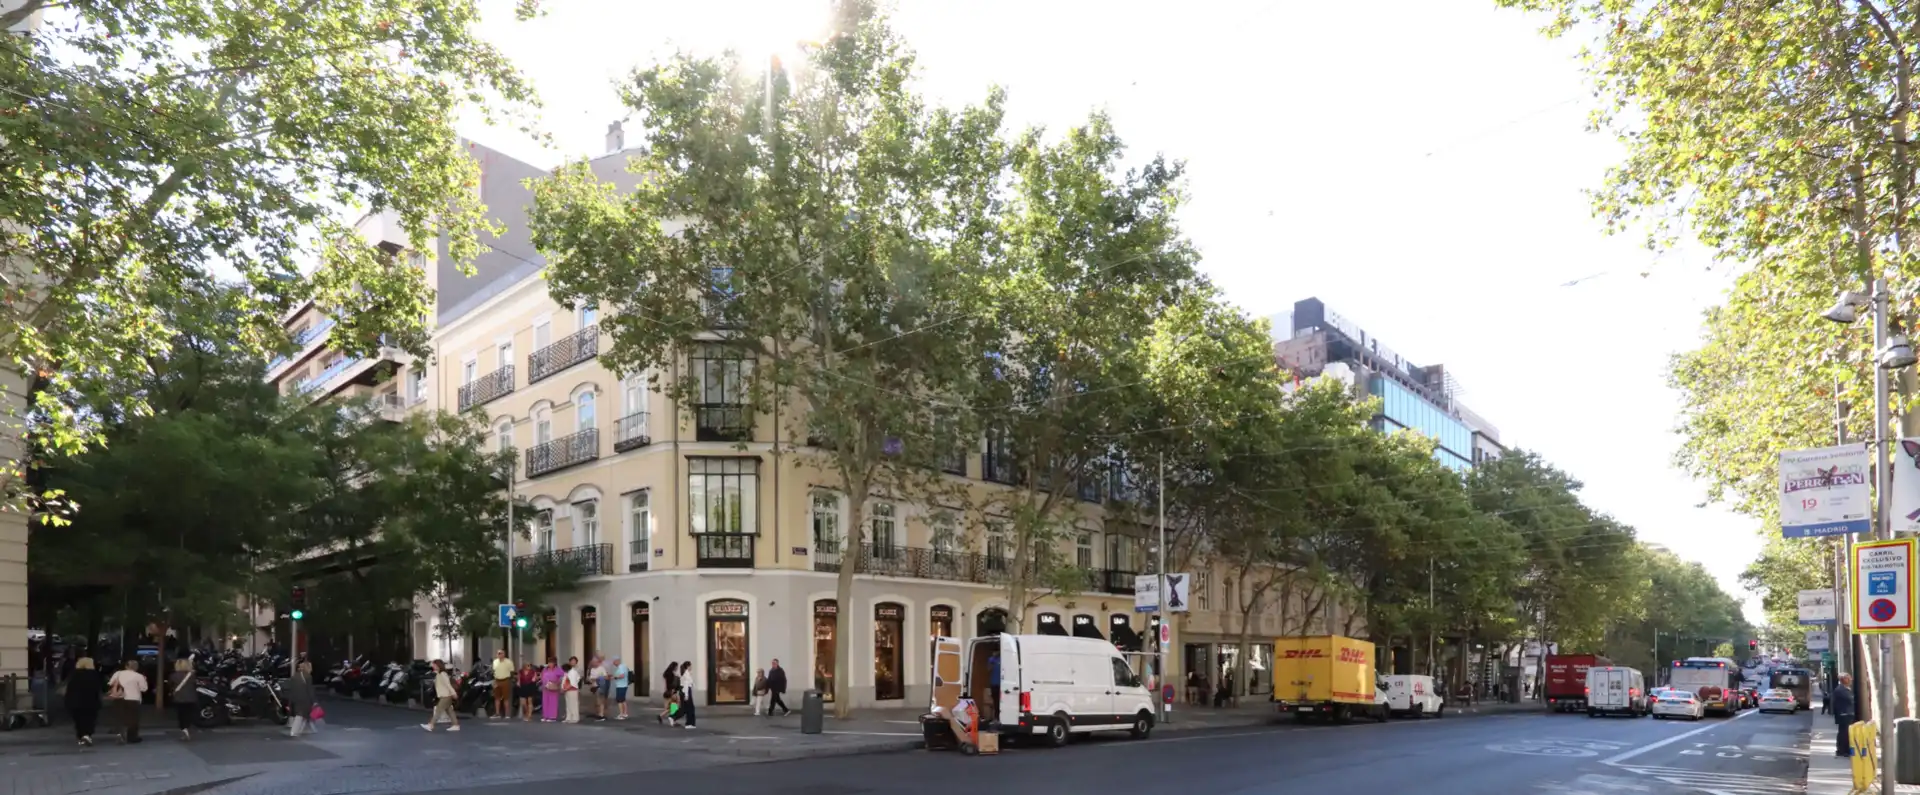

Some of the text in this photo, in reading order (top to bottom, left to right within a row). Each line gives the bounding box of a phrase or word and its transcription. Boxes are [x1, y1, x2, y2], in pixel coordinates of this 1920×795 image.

[1786, 472, 1863, 492] PERRTN
[1801, 498, 1817, 510] 19
[1814, 526, 1848, 535] MADRID
[1284, 649, 1323, 659] DHL
[1340, 647, 1367, 664] DHL
